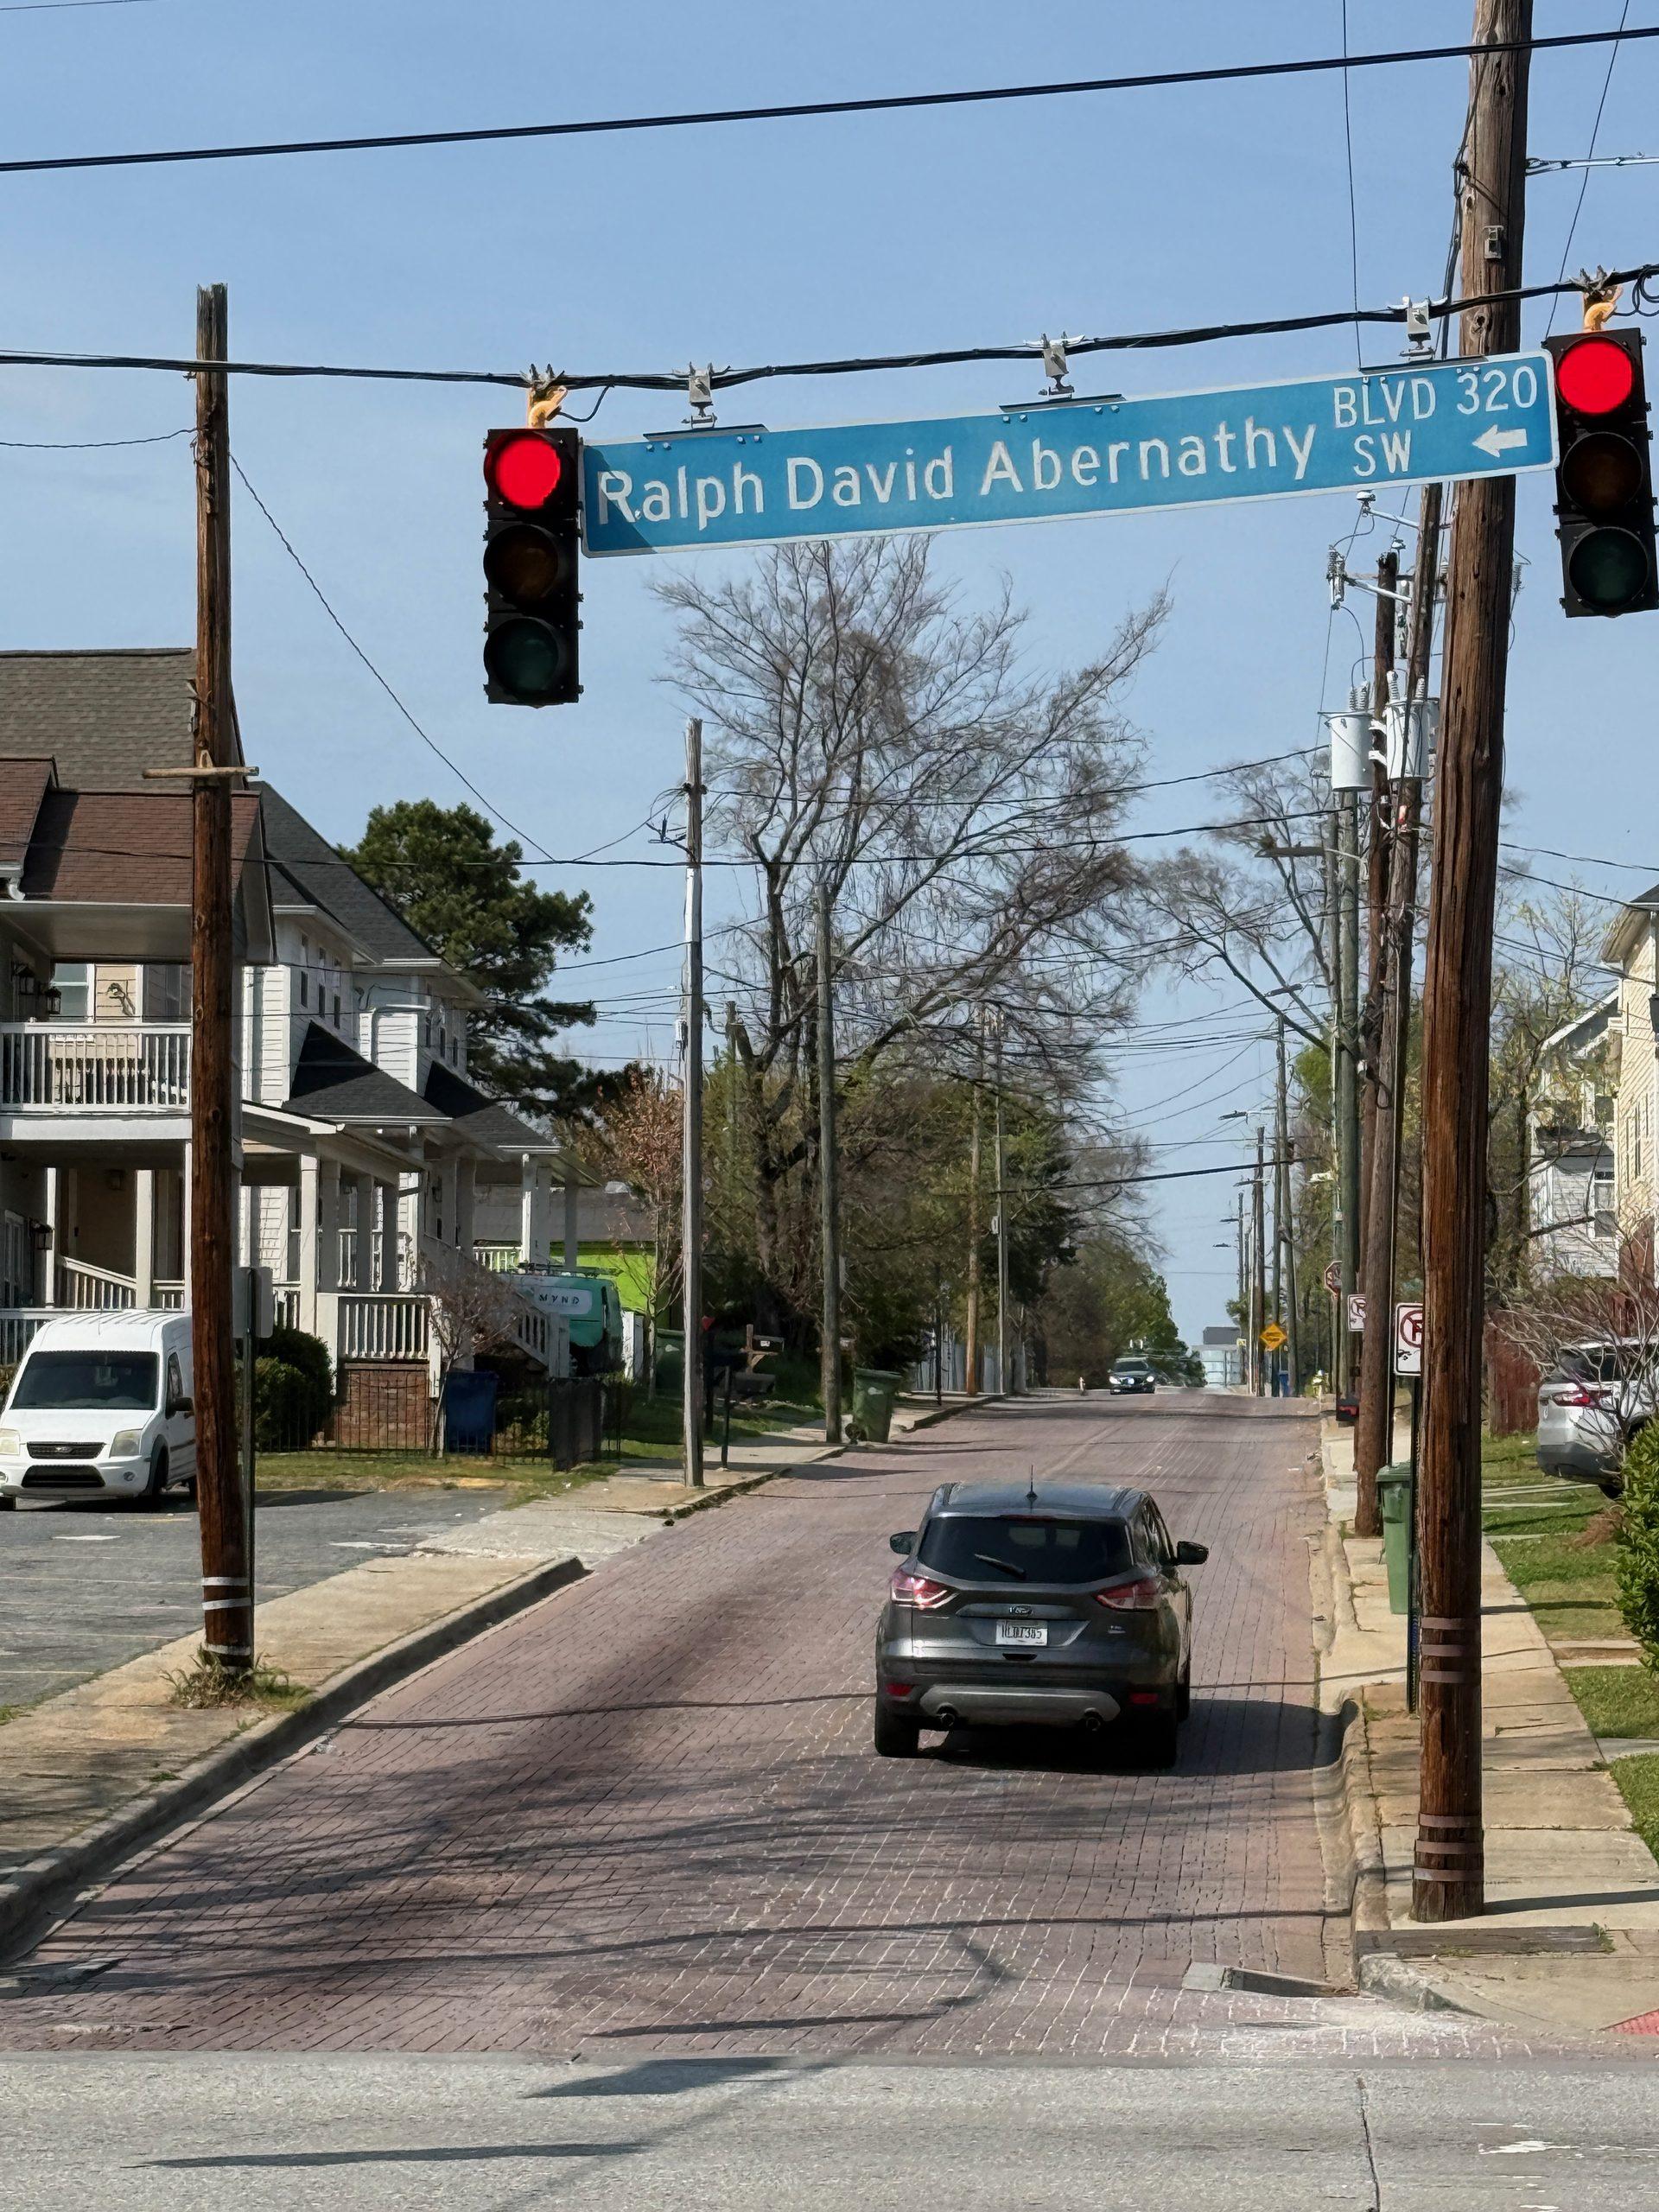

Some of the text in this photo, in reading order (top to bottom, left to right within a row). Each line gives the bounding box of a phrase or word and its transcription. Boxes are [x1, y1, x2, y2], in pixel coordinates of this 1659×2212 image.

[1333, 365, 1538, 429] BLVD 320
[597, 415, 1317, 531] Ralph David Abernathy
[1352, 429, 1412, 478] SW
